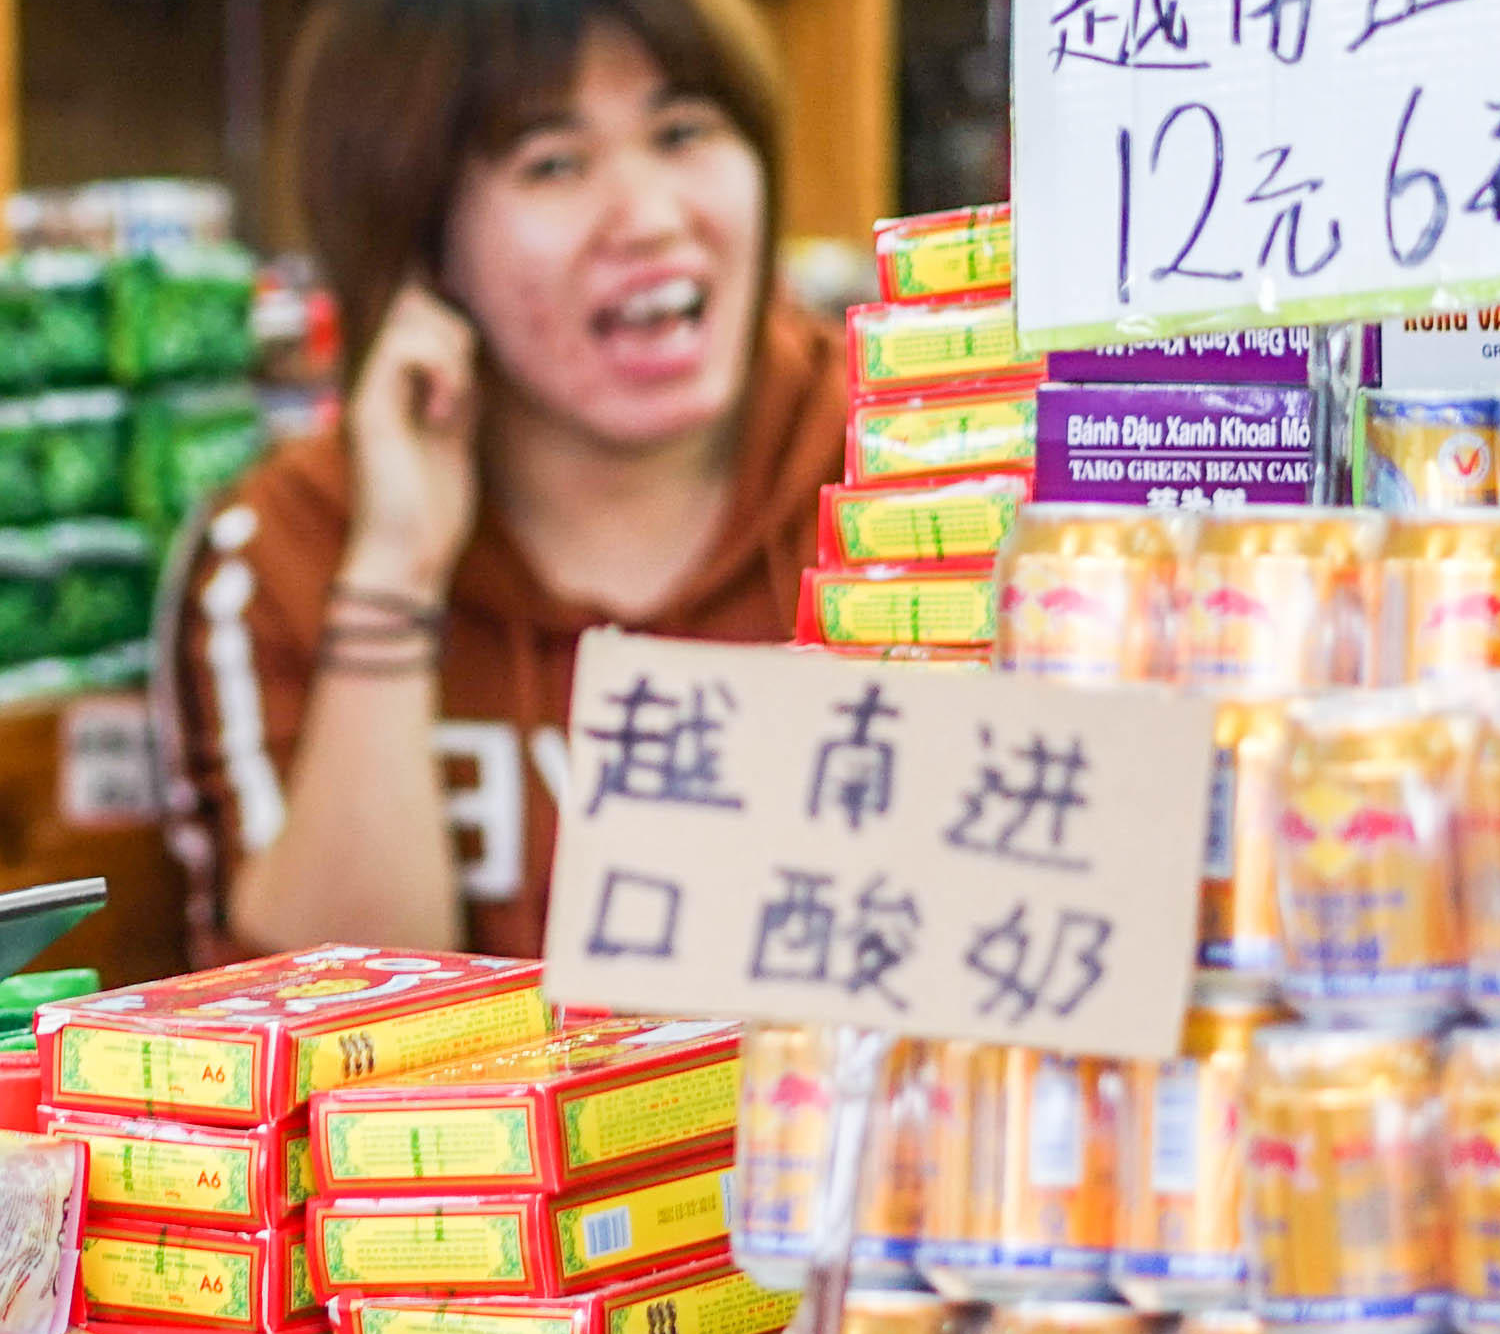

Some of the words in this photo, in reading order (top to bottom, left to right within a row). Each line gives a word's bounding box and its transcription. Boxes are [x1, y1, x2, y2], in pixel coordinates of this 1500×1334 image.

[1067, 414, 1119, 447] Bánh
[1121, 414, 1162, 451] Đậu
[1165, 415, 1218, 448] Xanh
[1220, 415, 1278, 448] Khoai
[1068, 459, 1126, 481] TARO
[1127, 459, 1202, 482] GREEN
[1205, 460, 1264, 482] BEAN
[582, 675, 1093, 873] 越南进
[585, 868, 1115, 1023] 口酸奶
[202, 1065, 225, 1083] A6
[197, 1171, 221, 1189] A6
[200, 1275, 223, 1294] A6
